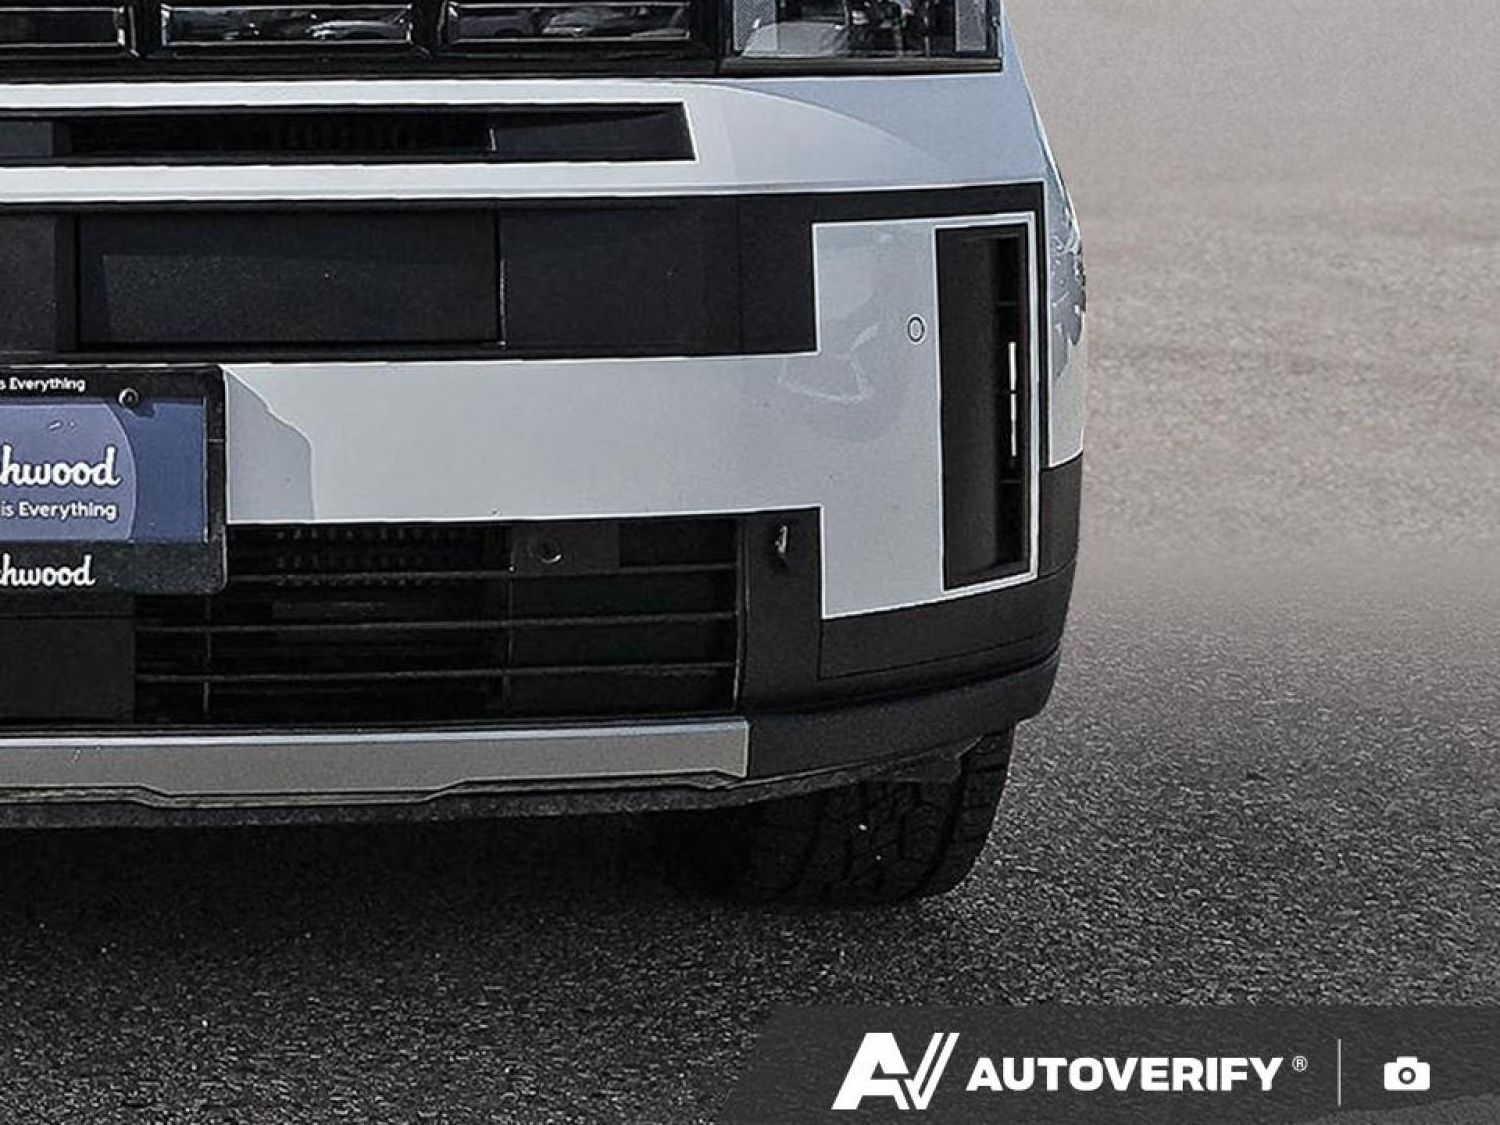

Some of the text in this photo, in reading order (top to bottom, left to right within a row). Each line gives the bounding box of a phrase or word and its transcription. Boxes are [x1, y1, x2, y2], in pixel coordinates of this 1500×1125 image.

[9, 377, 86, 393] Everything
[1, 501, 14, 518] is
[18, 501, 117, 521] Everything
